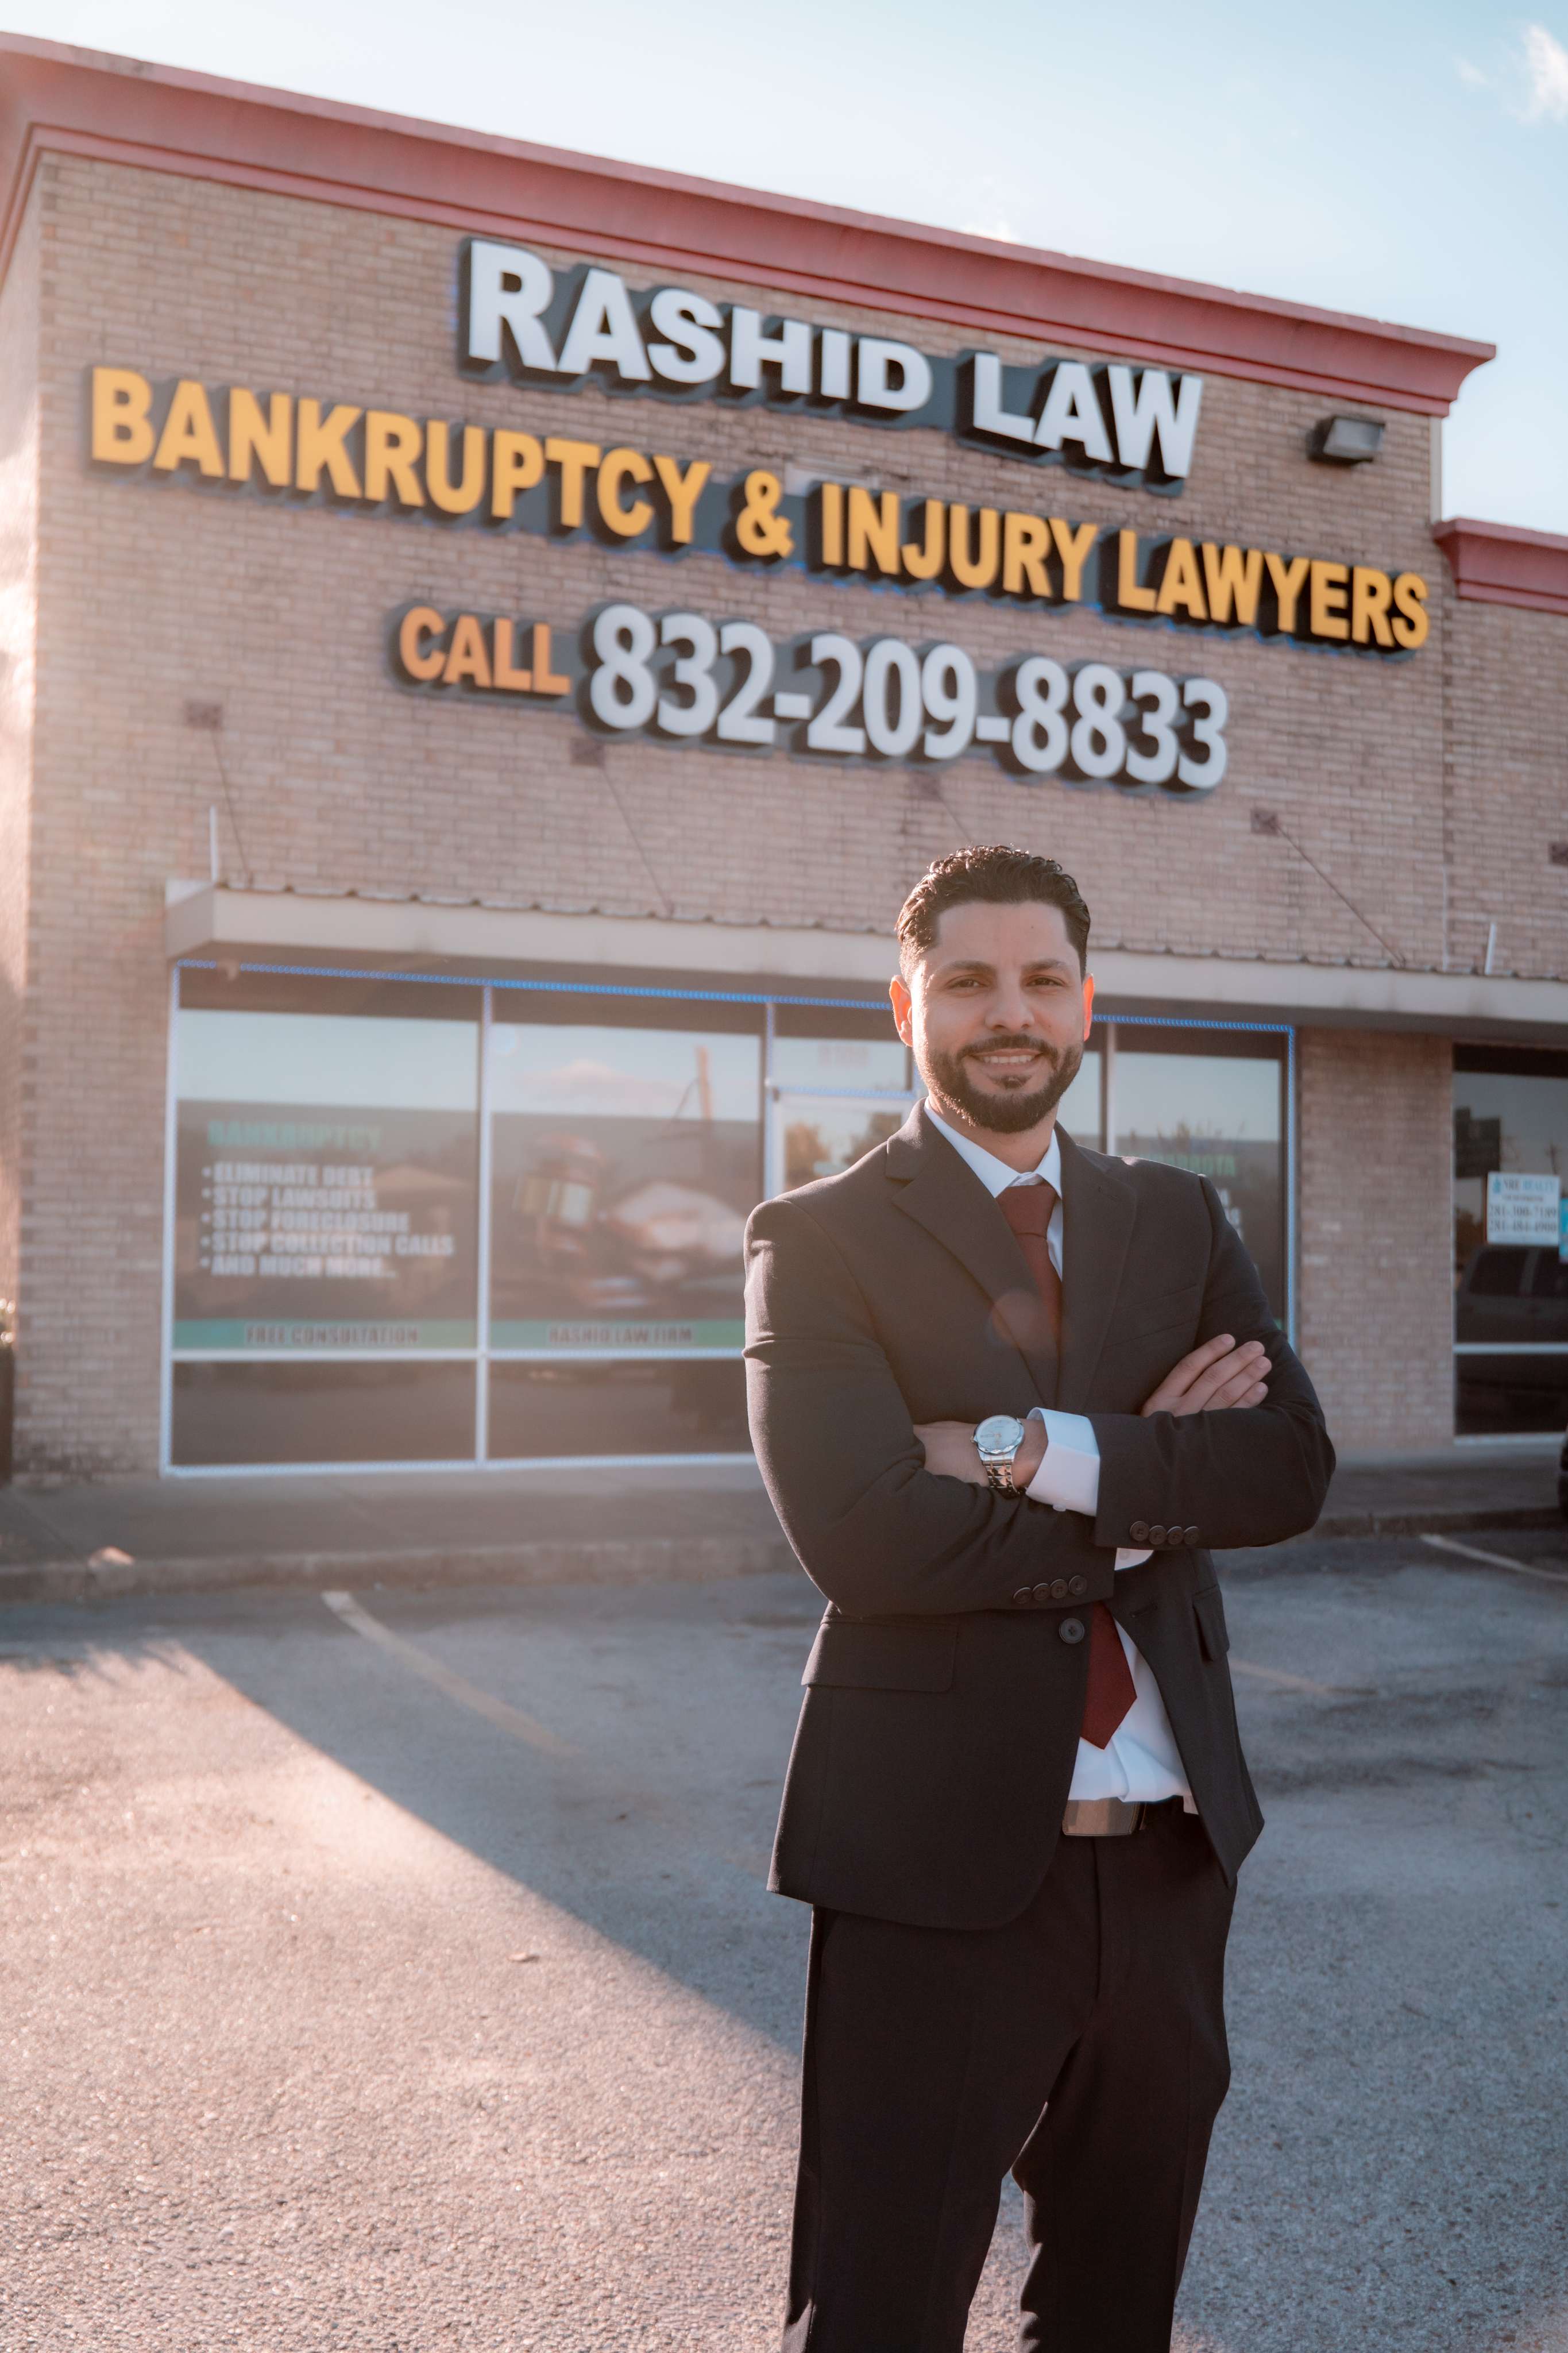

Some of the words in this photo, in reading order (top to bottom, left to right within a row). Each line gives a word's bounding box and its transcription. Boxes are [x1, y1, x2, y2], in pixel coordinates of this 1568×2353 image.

[468, 239, 934, 412] RASHID
[973, 352, 1203, 479] LAW
[91, 365, 712, 545] BANKRUPTCY
[736, 469, 794, 558] &
[821, 482, 1099, 603] INJURY
[1117, 528, 1430, 651] LAWYERS
[399, 605, 570, 696] CALL
[589, 602, 1229, 789] 832-209-8833
[213, 1161, 317, 1185] ELIMINATE
[322, 1166, 373, 1187] DEBT
[213, 1185, 268, 1207] STOP
[272, 1187, 377, 1210] LAWSUITS
[212, 1208, 267, 1230] STOP
[271, 1210, 410, 1233] FORECLOSURE
[211, 1231, 268, 1253] STOP
[271, 1232, 391, 1255] COLLECTION
[395, 1235, 455, 1256] CALLS
[211, 1254, 256, 1276] AND
[258, 1255, 322, 1277] MUCH
[246, 1326, 285, 1343] FREE
[291, 1326, 419, 1343] CONSULTATION
[549, 1326, 611, 1343] RASHID
[615, 1326, 648, 1343] LAW
[654, 1326, 692, 1344] FIRM
